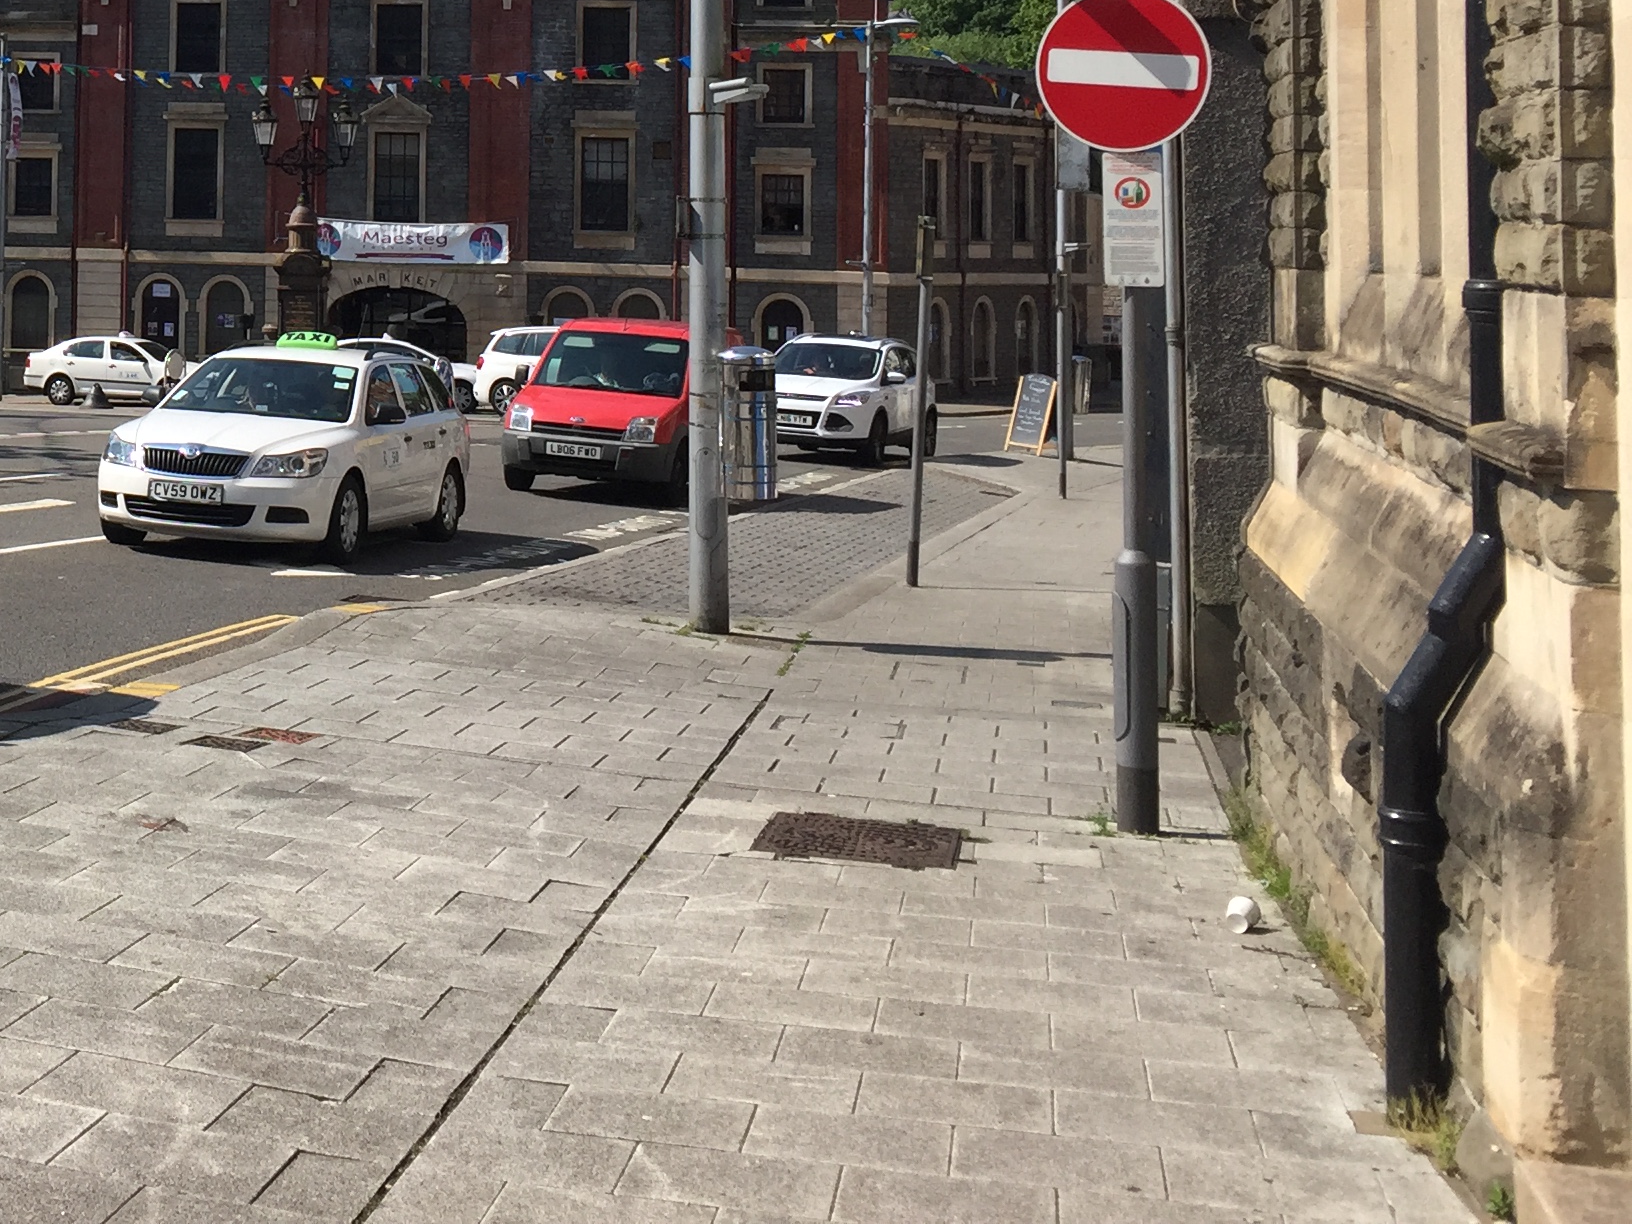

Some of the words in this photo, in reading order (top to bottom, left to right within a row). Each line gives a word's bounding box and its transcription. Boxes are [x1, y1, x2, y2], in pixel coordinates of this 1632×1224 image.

[362, 231, 448, 248] Maesteg
[352, 272, 438, 288] MARKET
[285, 332, 332, 344] TAXI
[154, 482, 188, 498] CV59
